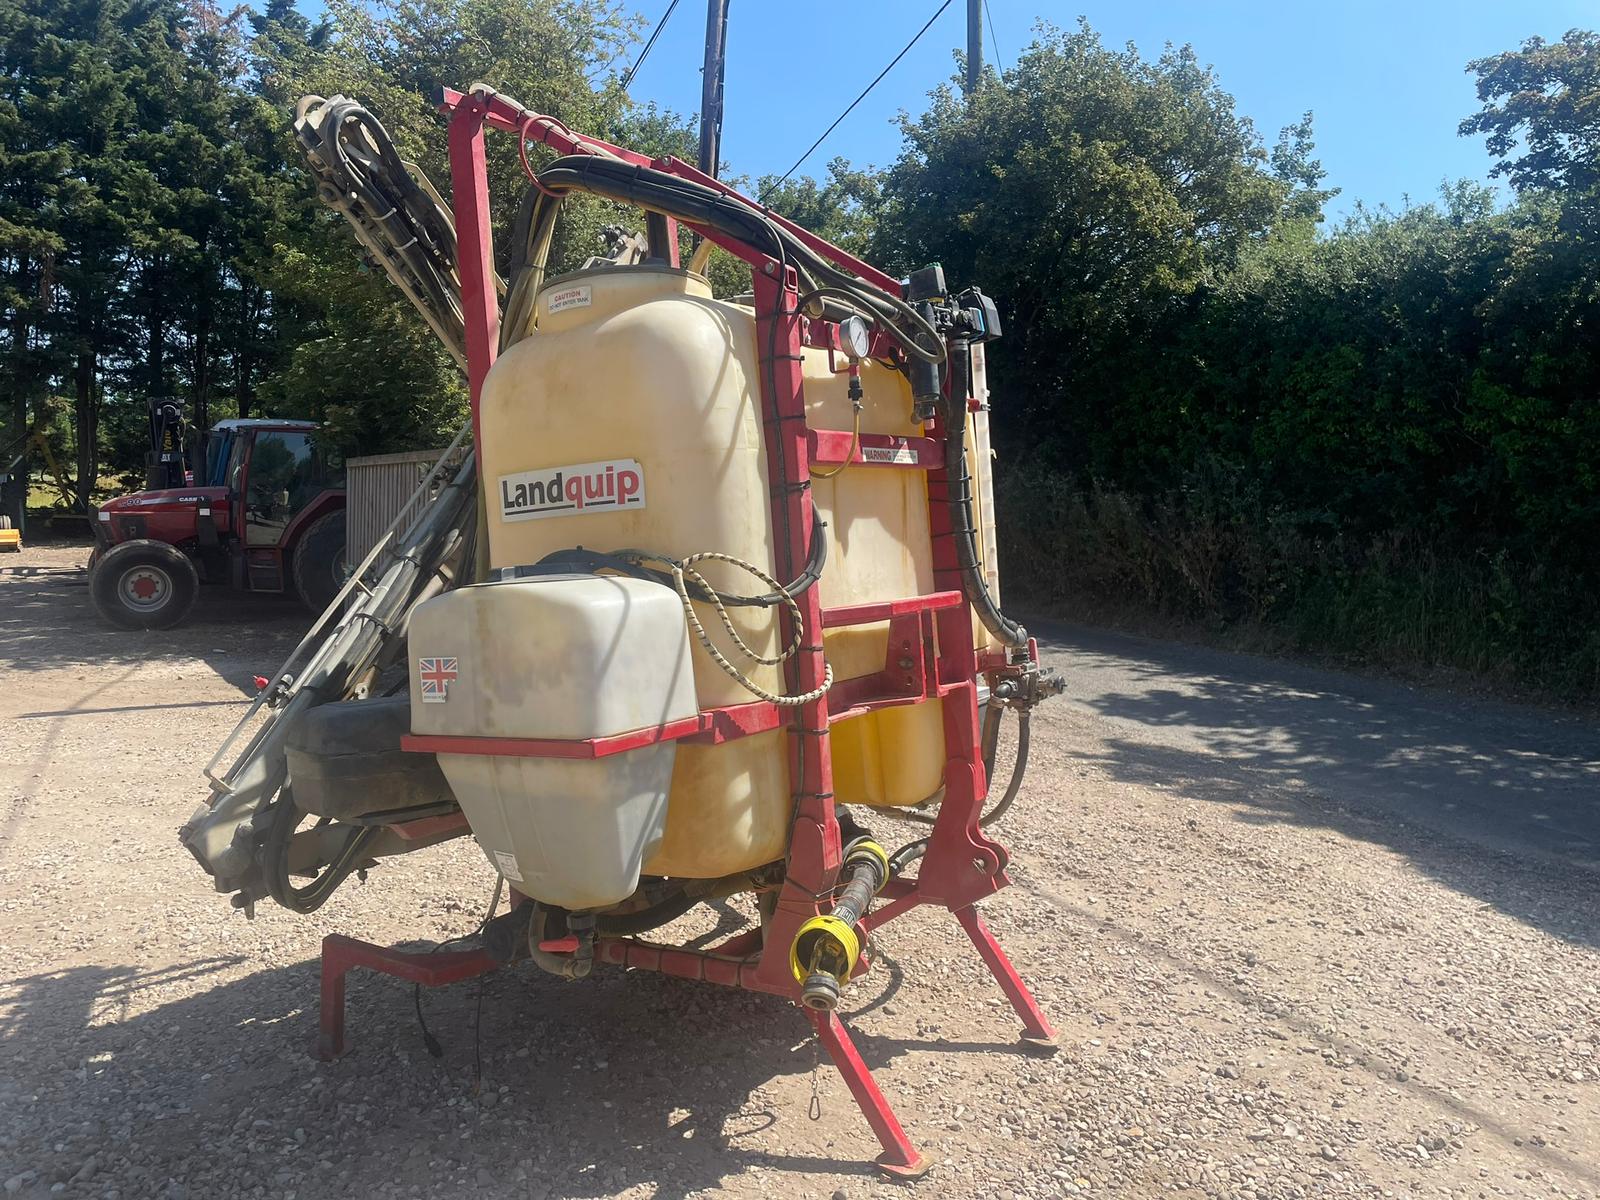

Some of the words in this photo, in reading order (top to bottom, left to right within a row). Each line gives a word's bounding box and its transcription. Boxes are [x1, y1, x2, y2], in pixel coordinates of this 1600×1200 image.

[554, 290, 581, 302] CAUTION
[864, 449, 891, 462] WARNING
[502, 466, 640, 509] Landquip
